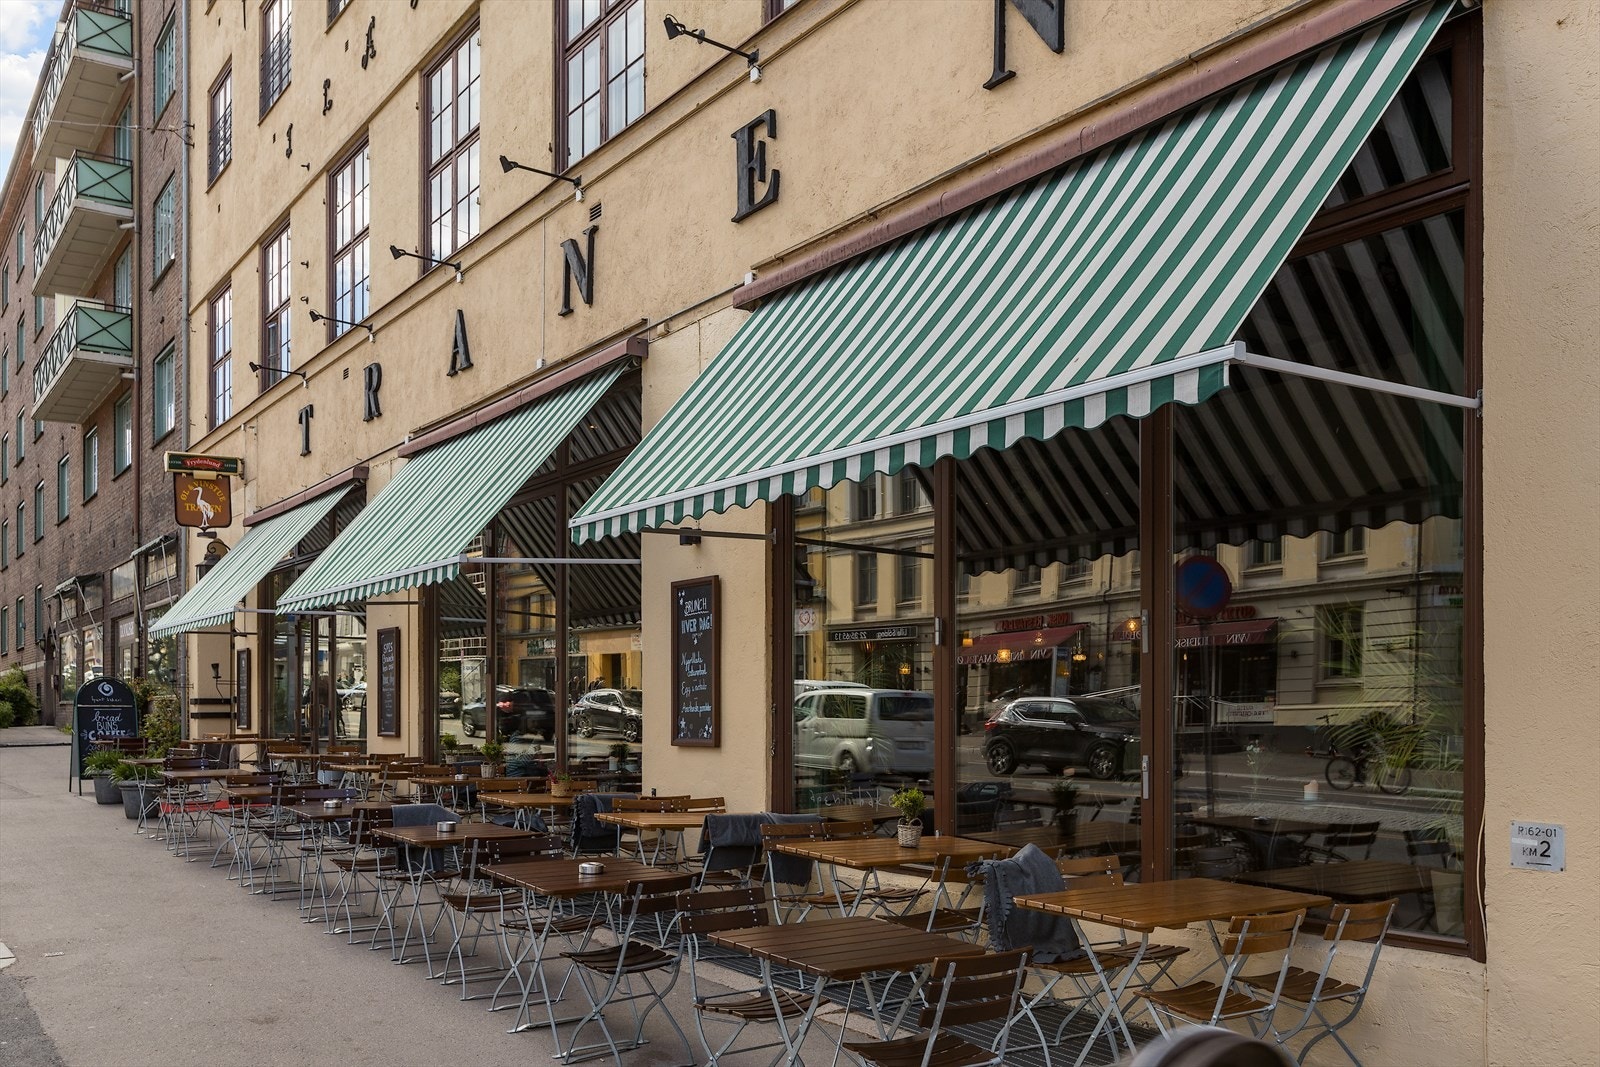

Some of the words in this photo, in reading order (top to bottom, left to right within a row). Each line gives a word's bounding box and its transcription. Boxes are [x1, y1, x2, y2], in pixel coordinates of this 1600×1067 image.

[186, 458, 221, 468] Frydenlund
[180, 490, 190, 501] ØL
[193, 481, 226, 502] VINSTUE
[684, 597, 707, 615] BRUNCH
[92, 711, 122, 722] bread
[97, 721, 119, 731] BUNS
[1522, 846, 1537, 857] KM
[1540, 840, 1551, 858] 2
